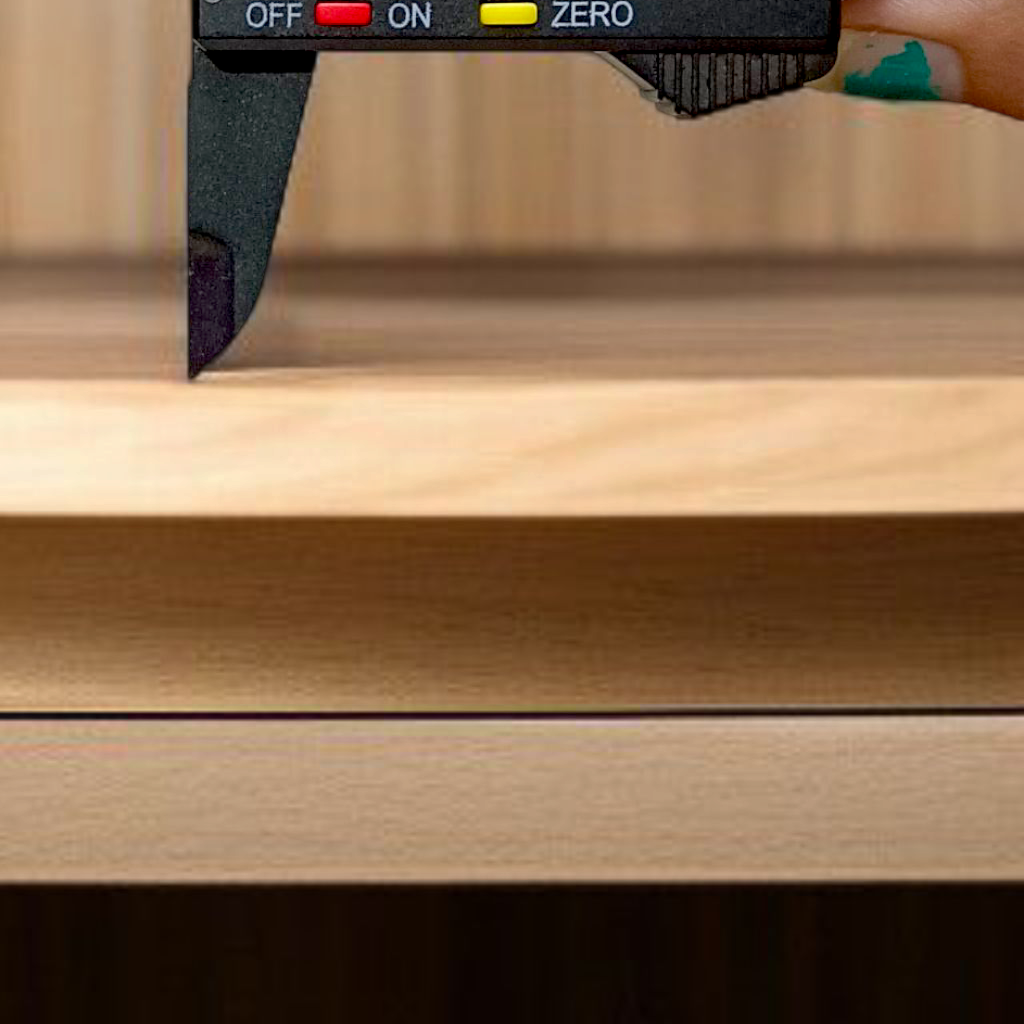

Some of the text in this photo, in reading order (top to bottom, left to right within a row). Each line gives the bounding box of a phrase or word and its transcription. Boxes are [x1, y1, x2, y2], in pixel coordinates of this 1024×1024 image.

[245, 0, 633, 29] OFF ON ZERO
